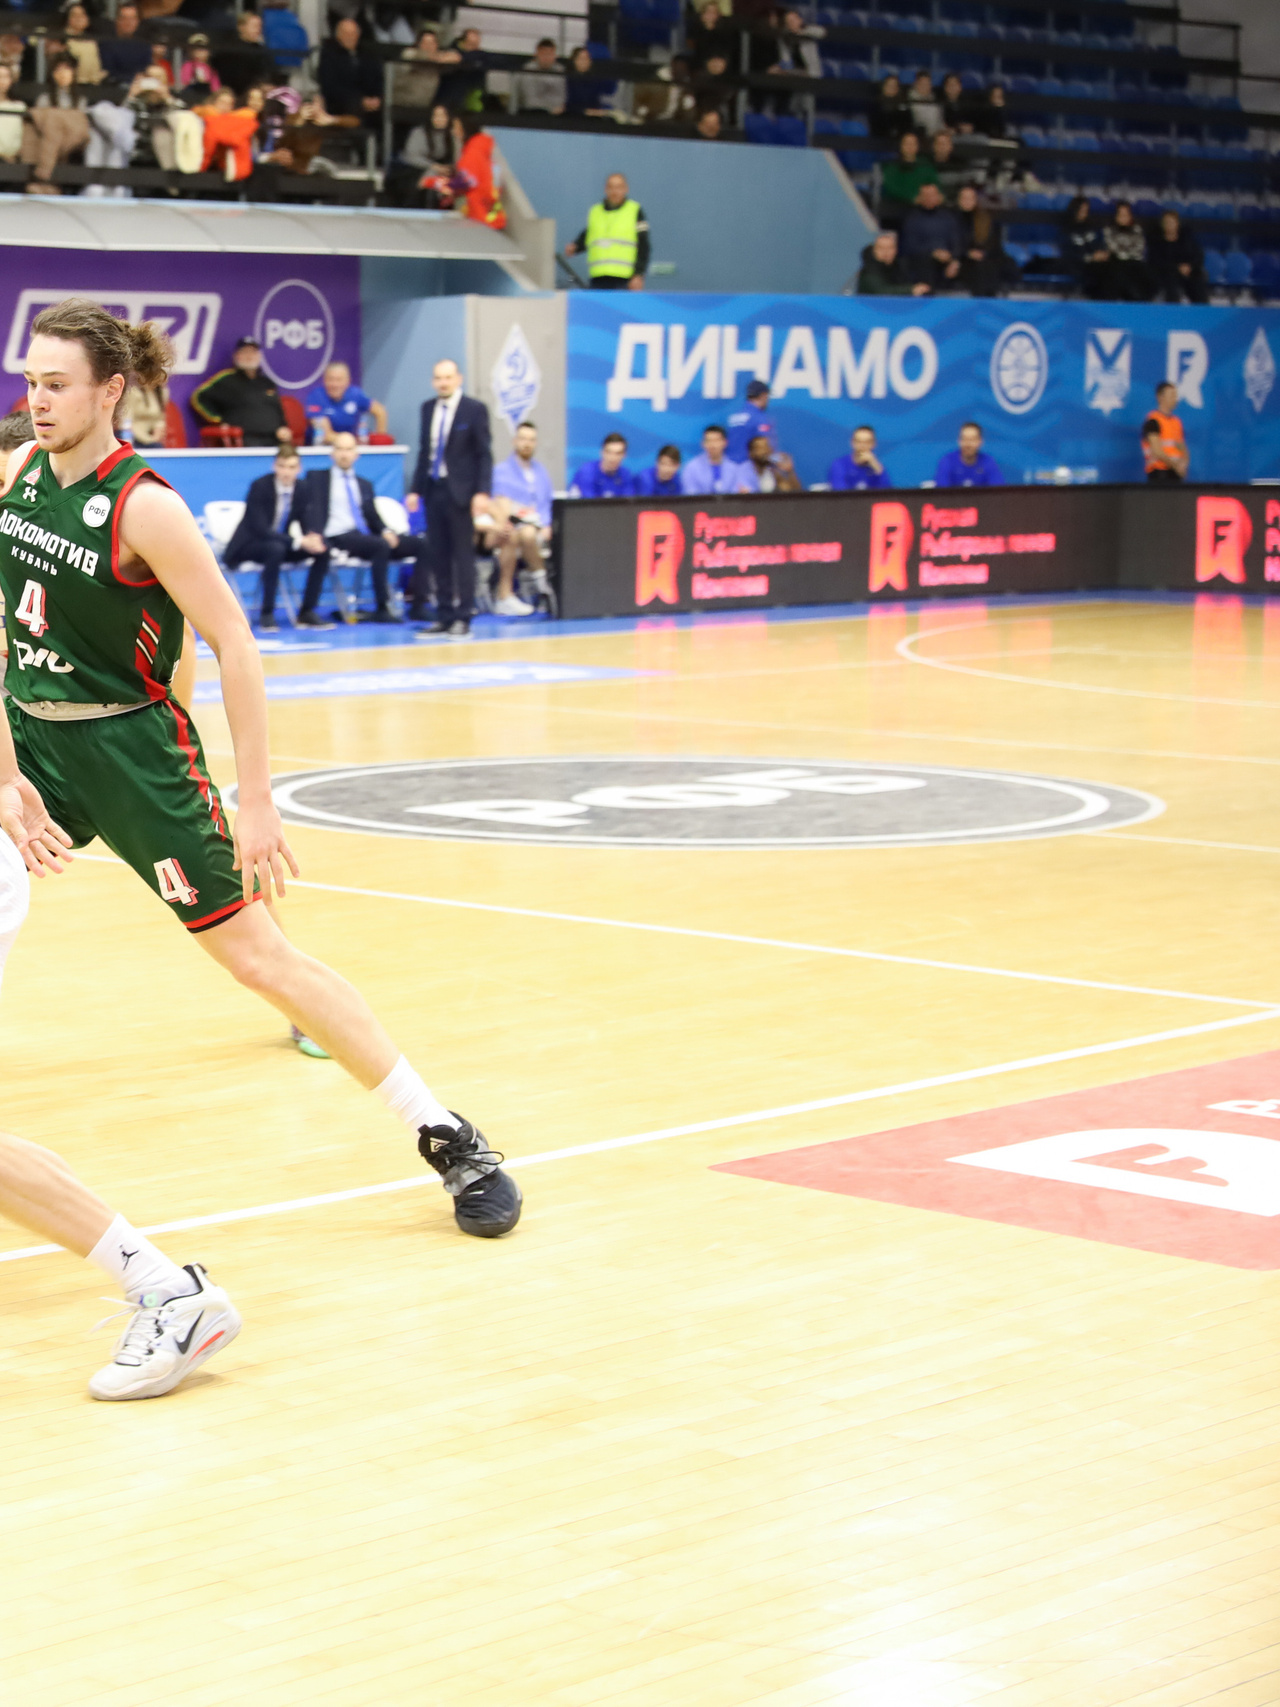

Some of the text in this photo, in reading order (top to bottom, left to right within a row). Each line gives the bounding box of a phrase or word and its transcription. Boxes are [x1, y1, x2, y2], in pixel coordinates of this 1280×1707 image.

[265, 319, 325, 349] РФБ
[606, 322, 938, 412] ДИНАМО
[88, 504, 107, 518] РФБ
[10, 545, 58, 576] КУБАНЬ
[15, 579, 49, 637] 4
[153, 857, 199, 906] 4
